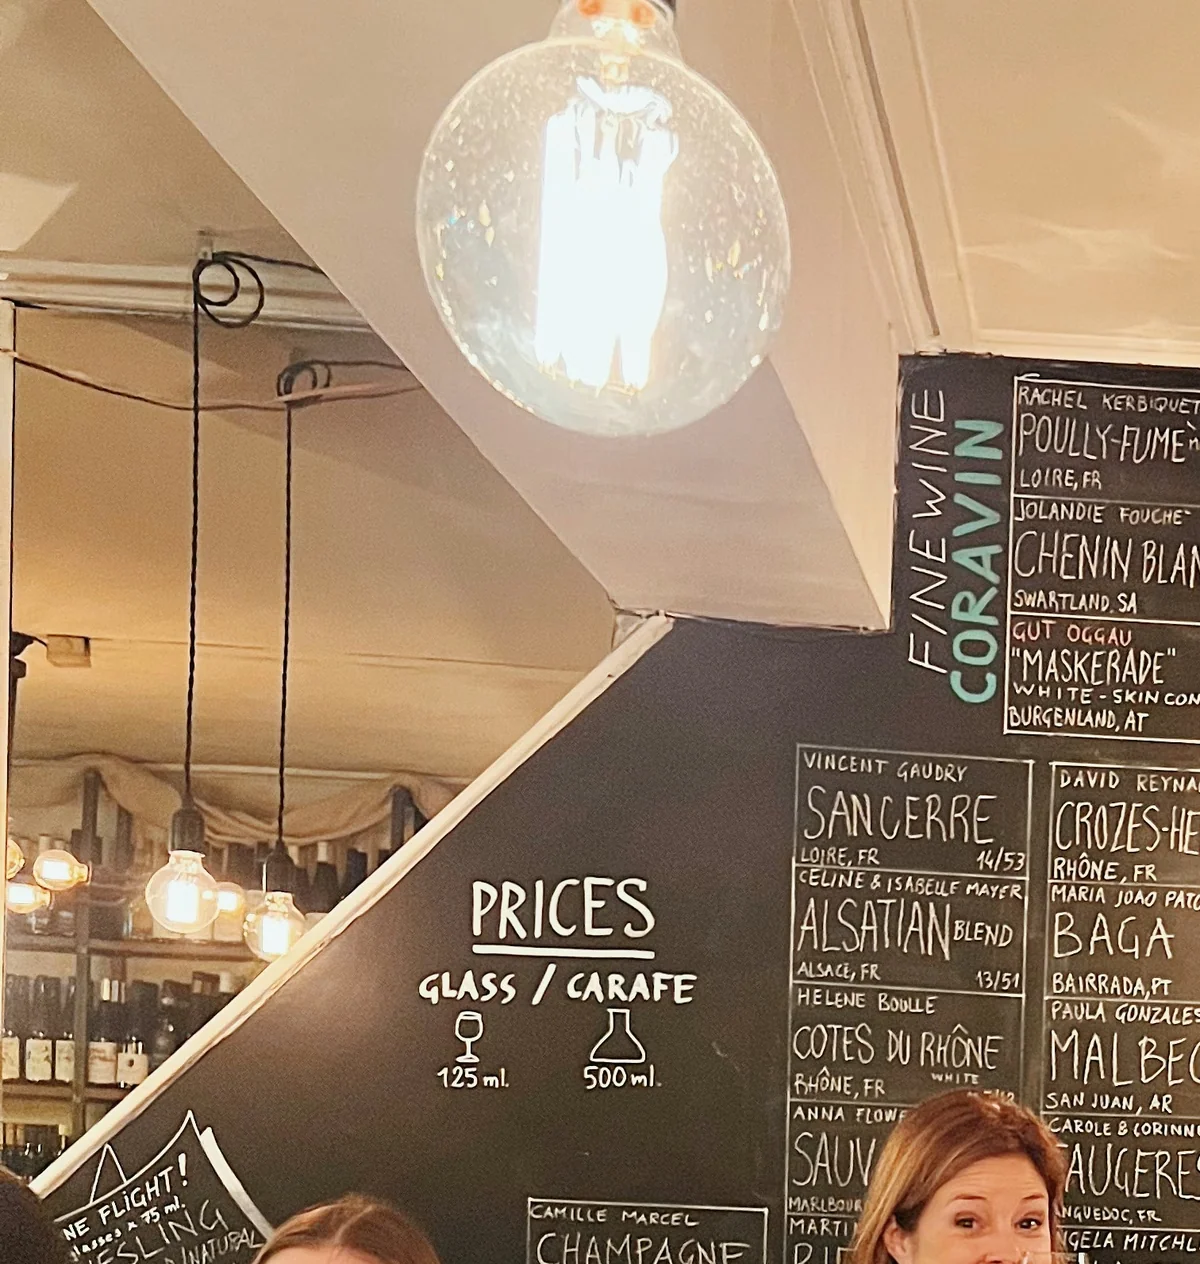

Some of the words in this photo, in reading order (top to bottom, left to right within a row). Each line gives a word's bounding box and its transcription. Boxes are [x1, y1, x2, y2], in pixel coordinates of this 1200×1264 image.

[1018, 385, 1087, 410] RACHEL
[909, 388, 950, 519] WINE
[1014, 499, 1105, 523] JOLANDIE
[950, 419, 1004, 704] CORAVIN
[1014, 530, 1132, 583] CHENIN
[908, 529, 949, 675] FINE
[1117, 591, 1138, 614] SA
[1012, 620, 1056, 644] GUT
[1066, 624, 1132, 647] OGGAU
[1010, 646, 1176, 686] "MASKERADE"
[803, 751, 890, 775] VINCENT
[896, 761, 969, 783] GAUDRY
[1059, 768, 1120, 789] DAVID
[803, 785, 998, 845] SANCERRE
[857, 848, 881, 866] FR
[799, 869, 865, 890] CELINE
[870, 872, 882, 890] &
[887, 876, 960, 898] ISABELLE
[965, 881, 1024, 900] MAYER
[1133, 863, 1157, 882] FR
[471, 876, 656, 940] PRICES
[1051, 885, 1106, 904] MARIA
[1114, 890, 1157, 908] JOAO
[797, 896, 951, 962] ALSATIAN
[953, 919, 1014, 948] BLEND
[1053, 911, 1176, 960] BAGA
[796, 961, 857, 982] ALSACE,
[860, 963, 882, 981] FR
[418, 969, 517, 1005] GLASS
[566, 971, 698, 1005] CARAFE
[796, 988, 867, 1009] HELENE
[1050, 1000, 1106, 1021] PAULA
[792, 1022, 876, 1065] COTES
[886, 1029, 912, 1067] DU
[920, 1023, 1004, 1071] RHÔNE
[436, 1066, 478, 1089] 125
[583, 1065, 628, 1090] 500
[864, 1078, 886, 1096] FR
[931, 1071, 980, 1085] WHITE
[793, 1105, 847, 1122] ANNA
[1045, 1092, 1085, 1110] SAN
[1149, 1094, 1173, 1114] AR
[1049, 1118, 1112, 1137] CAROLE
[140, 1206, 161, 1225] 75
[529, 1204, 608, 1223] CAMILLE
[621, 1209, 700, 1227] MARCEL
